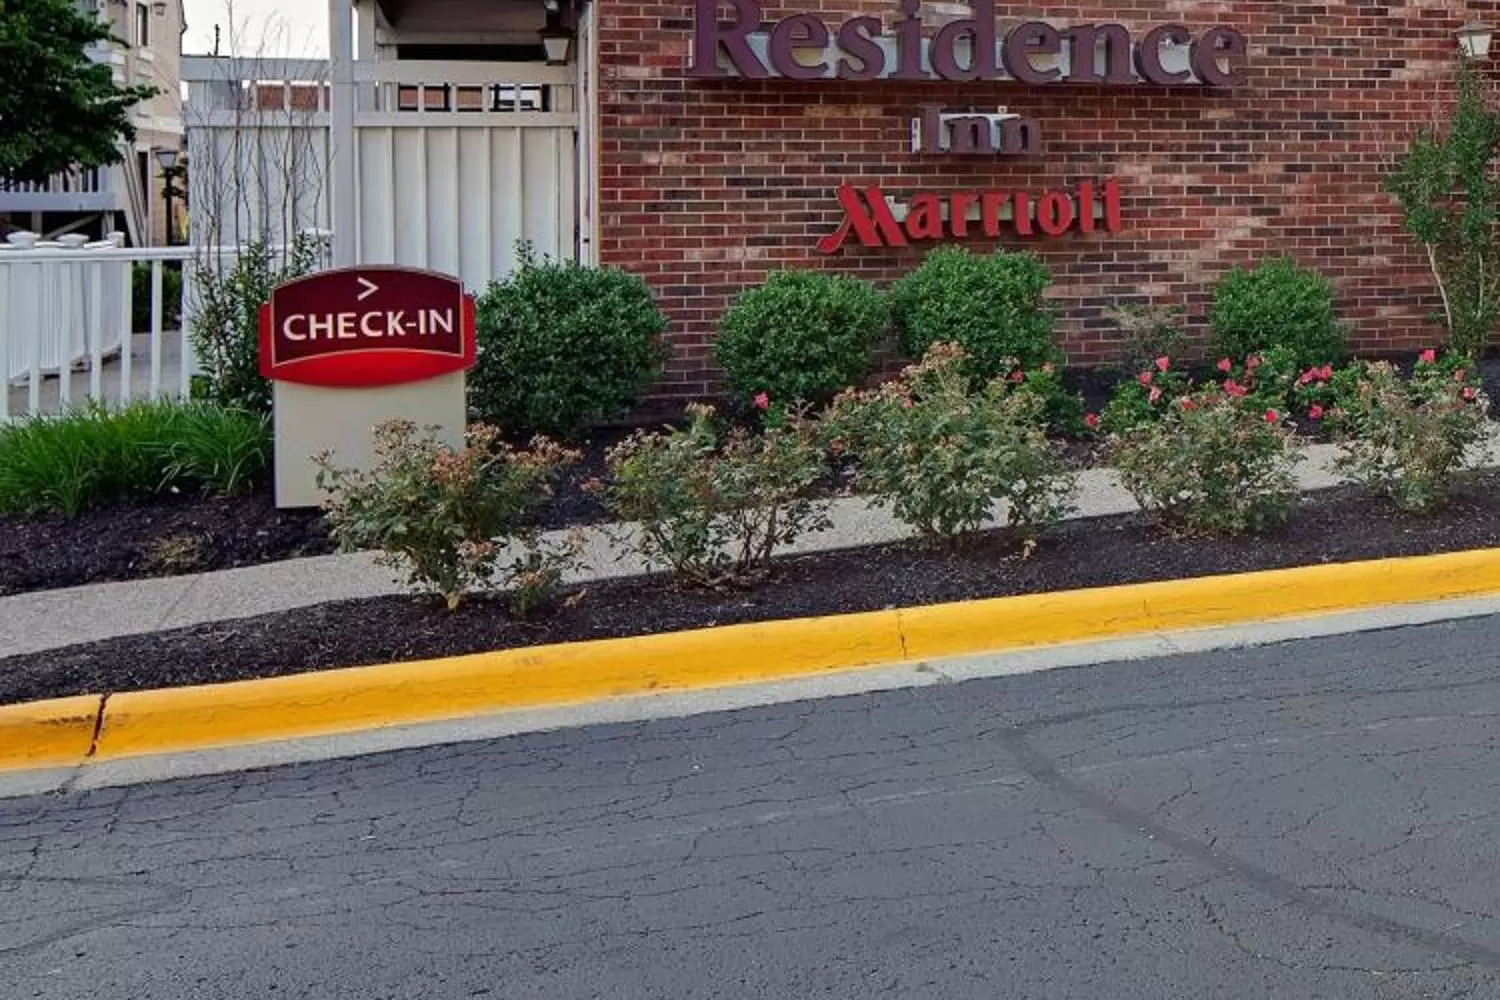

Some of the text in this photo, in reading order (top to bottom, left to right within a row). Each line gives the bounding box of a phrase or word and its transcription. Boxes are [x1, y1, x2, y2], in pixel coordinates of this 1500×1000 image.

[917, 103, 1041, 155] Inn
[815, 175, 1123, 253] Marriott
[283, 308, 453, 341] CHECK-IN
